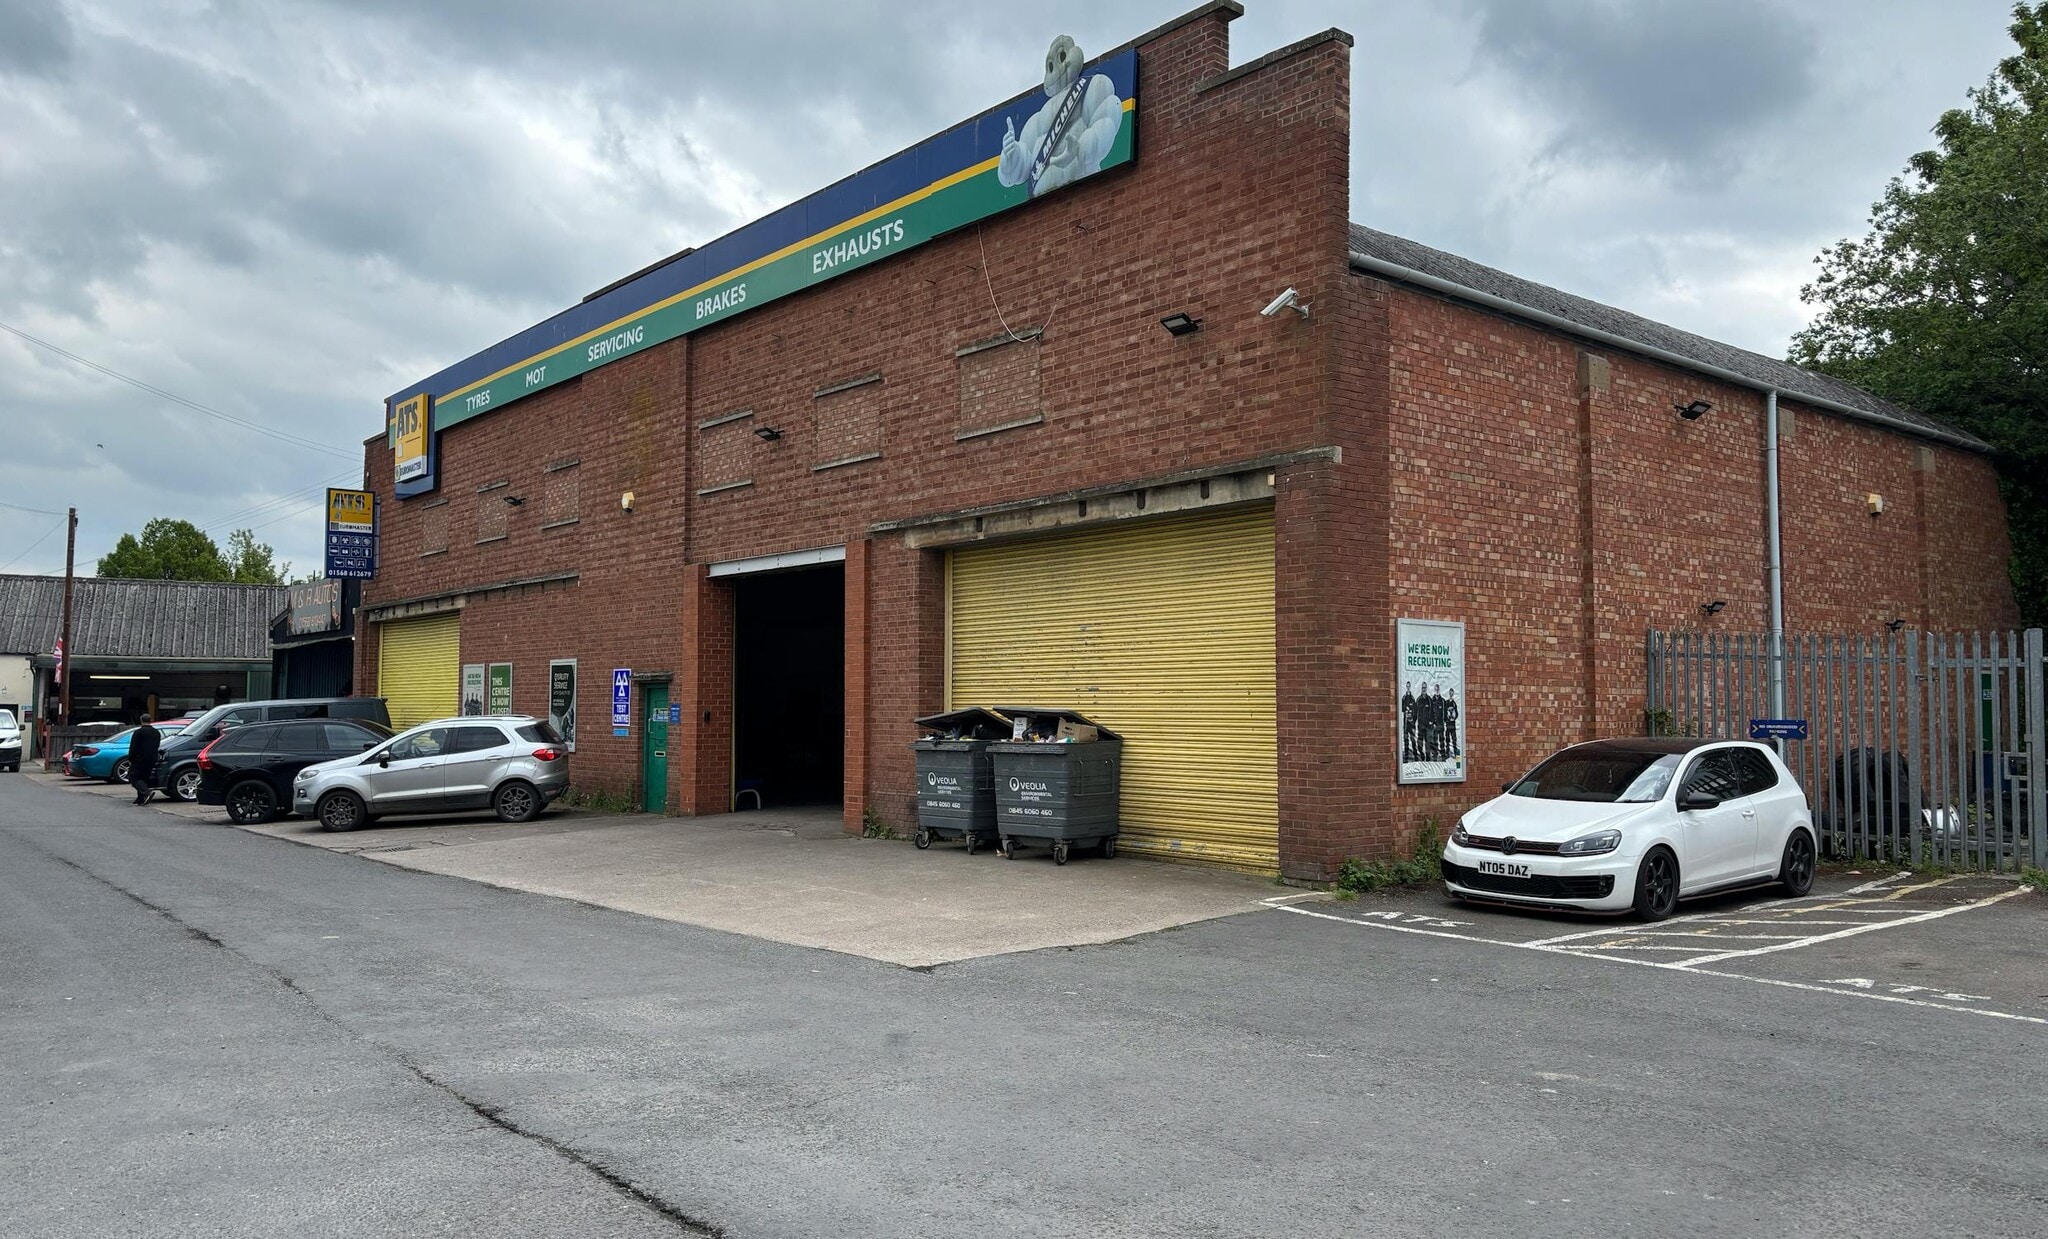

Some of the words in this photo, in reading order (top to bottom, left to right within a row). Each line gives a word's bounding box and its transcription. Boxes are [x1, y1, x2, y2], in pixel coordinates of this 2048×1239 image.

[1043, 77, 1087, 159] MICHELIN
[812, 219, 904, 274] EXHAUSTS
[696, 283, 746, 320] BRAKES
[587, 325, 643, 362] SERVICING
[525, 366, 546, 388] MOT
[466, 389, 490, 412] TYRES
[397, 401, 418, 439] ATS
[332, 493, 365, 510] ATS
[328, 569, 348, 577] 01568
[313, 582, 339, 605] AUTOS
[1408, 643, 1430, 655] WE'RE
[1432, 645, 1450, 655] NOW
[1408, 656, 1452, 668] RECRUITING
[491, 677, 503, 686] THIS
[553, 681, 568, 690] SERVICE
[491, 687, 510, 696] CENTRE
[491, 697, 497, 706] IS
[497, 697, 510, 706] NOW
[616, 704, 627, 713] TEST
[613, 714, 629, 723] CENTRE
[937, 777, 958, 785] VEOLIA
[1020, 782, 1047, 790] VEOLIA
[1479, 861, 1505, 874] NT05
[1508, 864, 1529, 877] DAZ
